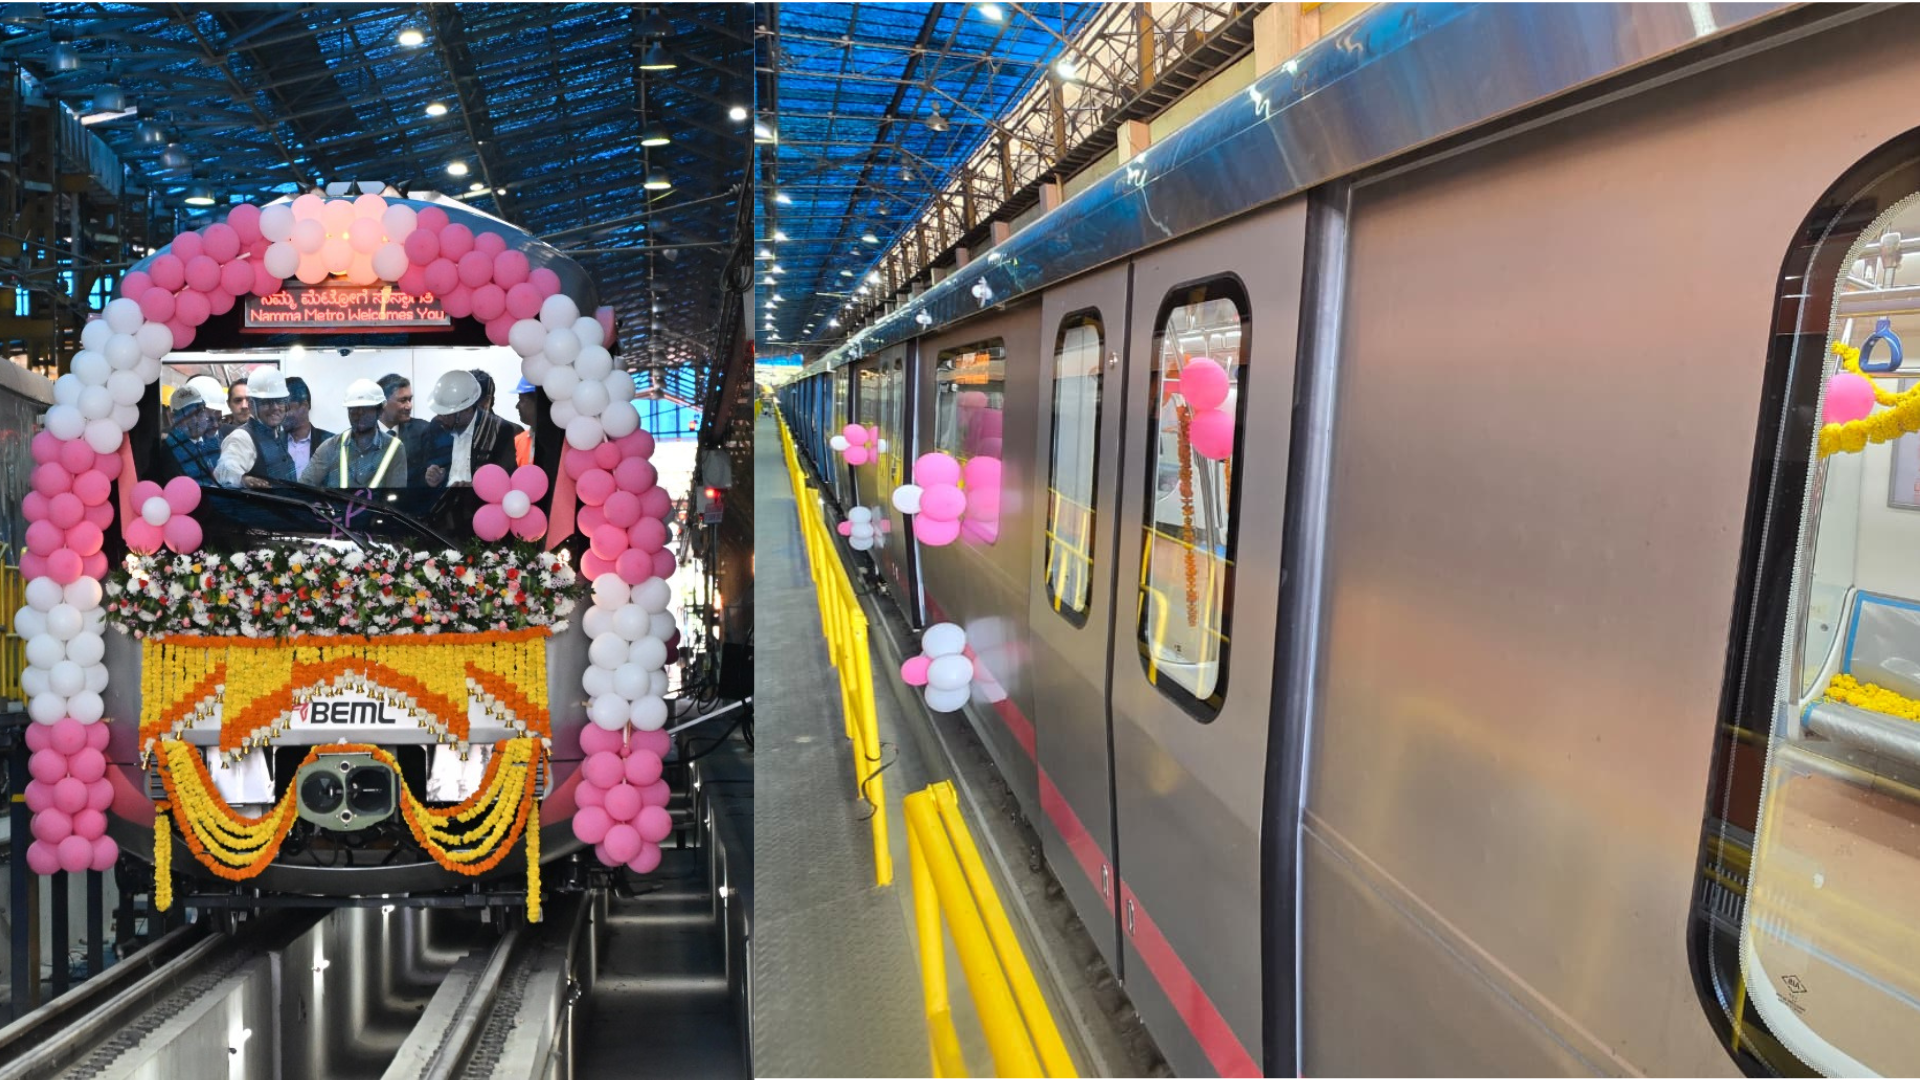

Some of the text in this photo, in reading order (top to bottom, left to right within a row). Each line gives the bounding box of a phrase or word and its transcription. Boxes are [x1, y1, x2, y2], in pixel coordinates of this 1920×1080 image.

[261, 291, 297, 310] ನಮ್ಮ
[301, 289, 368, 308] ಮೆಟ್ರೋಗೆ
[250, 307, 445, 322] Namma Metro Welcomes You
[311, 702, 396, 724] BEML
